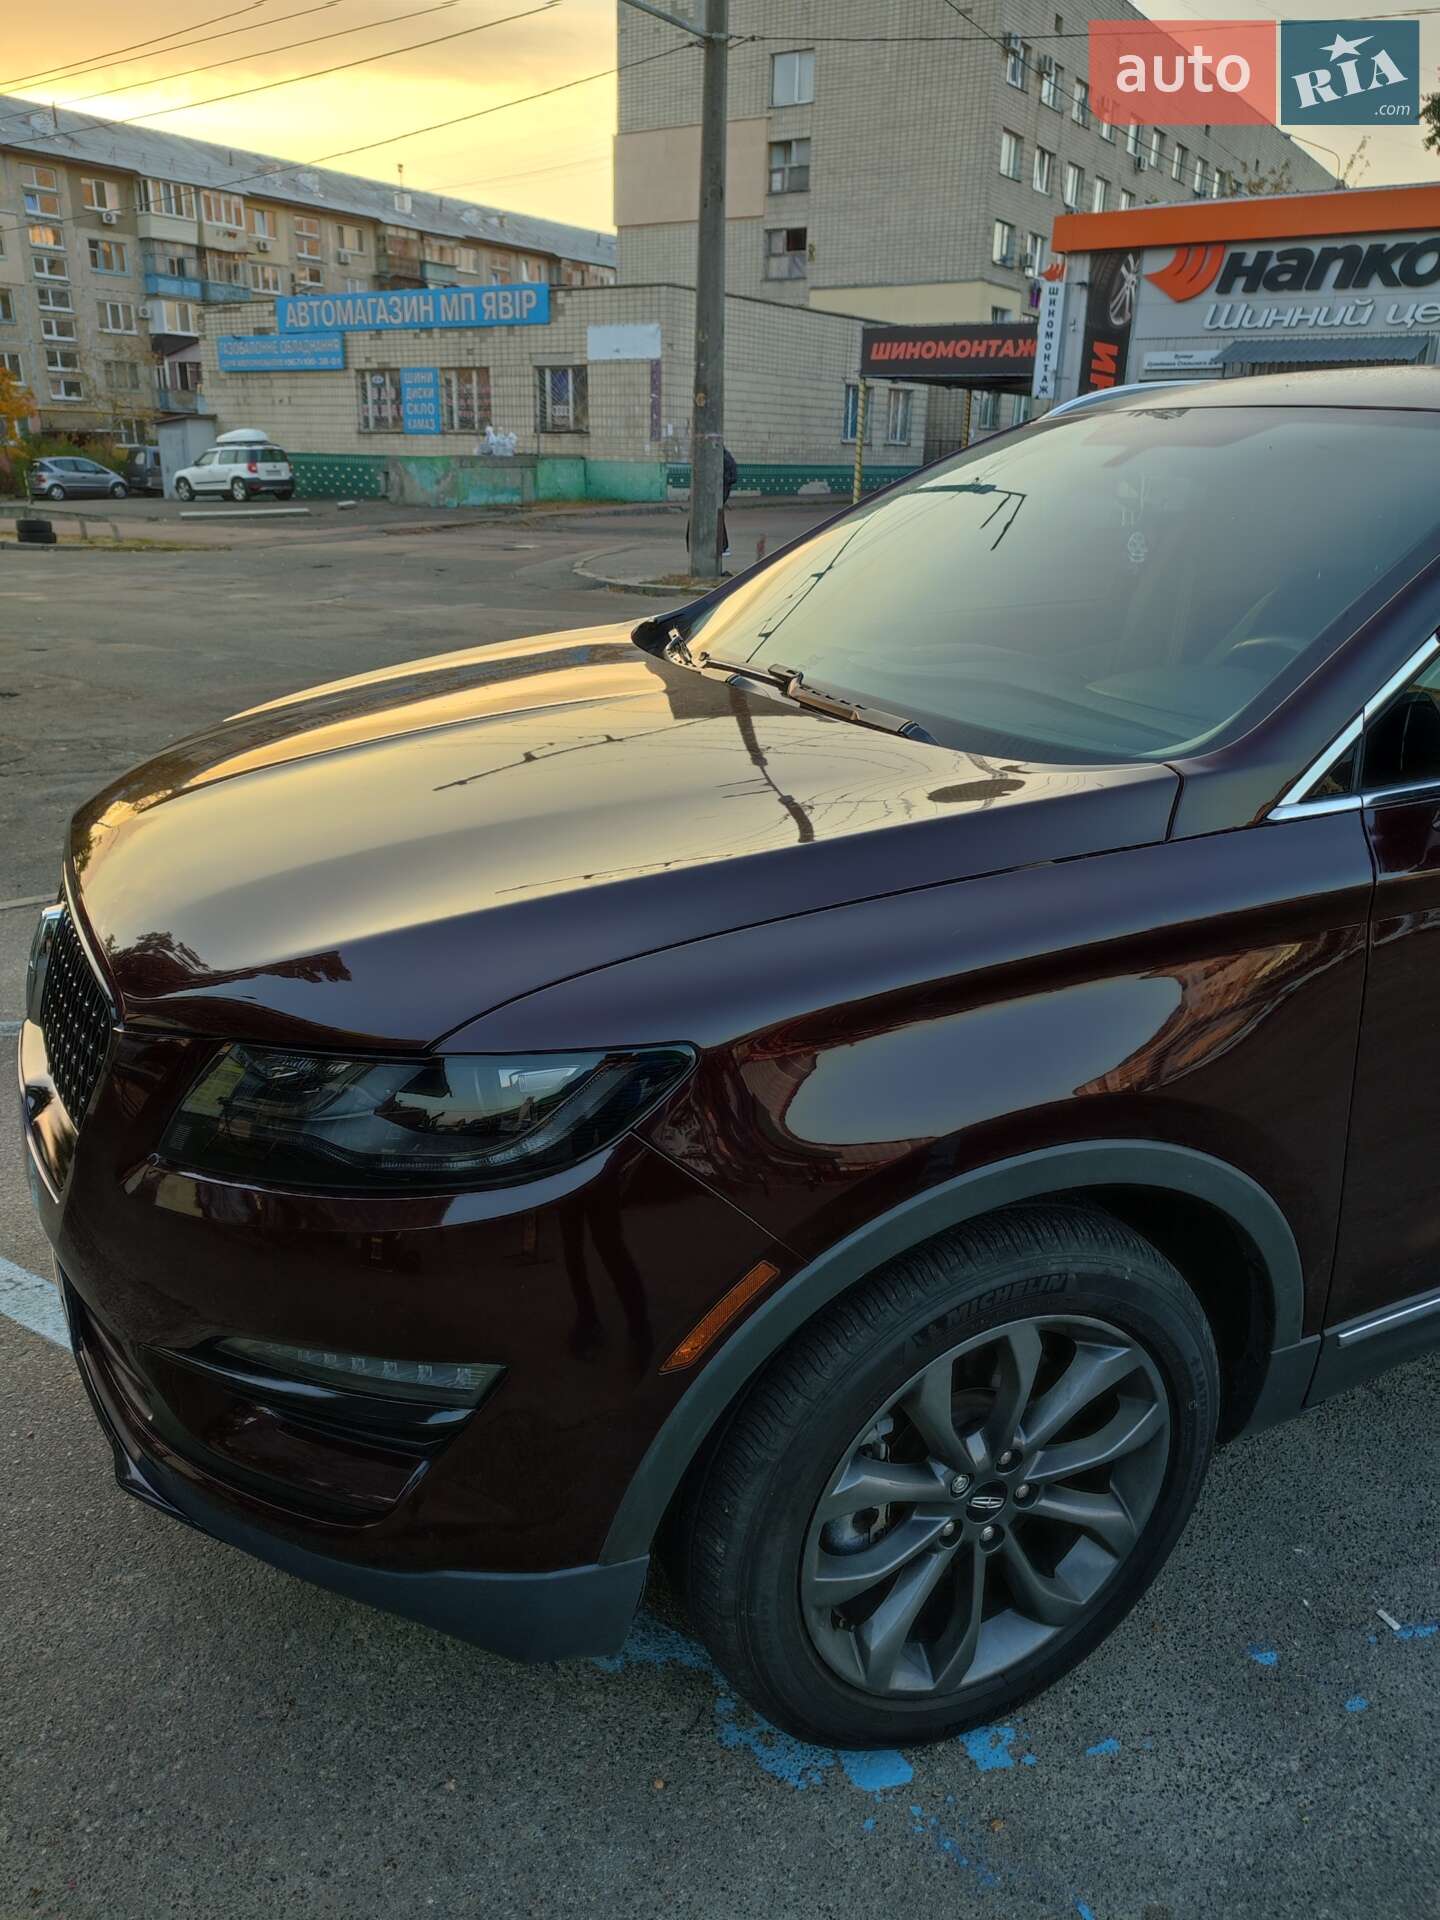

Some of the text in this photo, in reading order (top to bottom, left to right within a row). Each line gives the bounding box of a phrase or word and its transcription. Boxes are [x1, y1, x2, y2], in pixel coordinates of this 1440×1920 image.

[286, 289, 537, 328] АВТОМАГАЗИН МП ЯВІР
[1203, 299, 1376, 330] Шинний
[870, 338, 1038, 361] ШИНОМОНТАЖ
[1038, 287, 1059, 396] ШИНОМОНТАЖ
[406, 403, 435, 415] СКЛО
